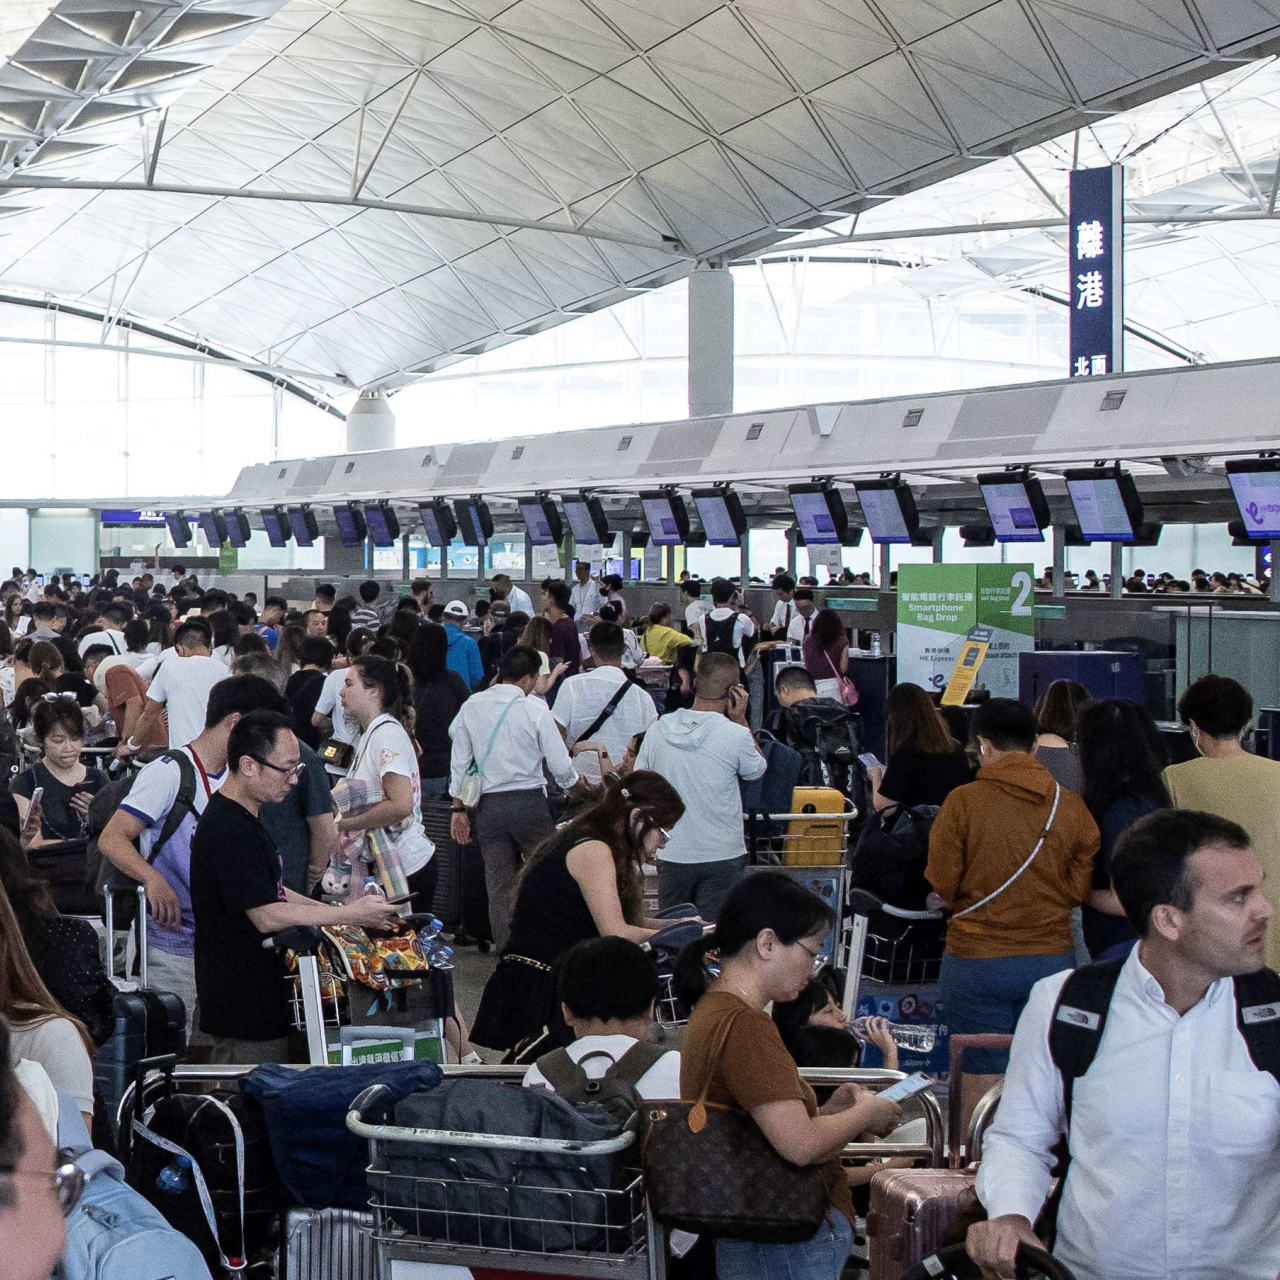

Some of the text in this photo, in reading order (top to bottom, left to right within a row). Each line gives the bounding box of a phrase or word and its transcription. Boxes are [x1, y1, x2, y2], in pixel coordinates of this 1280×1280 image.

[1077, 220, 1104, 309] 離港
[1011, 572, 1032, 616] 2
[908, 603, 965, 613] Smartphone
[917, 613, 958, 623] Bag Drop
